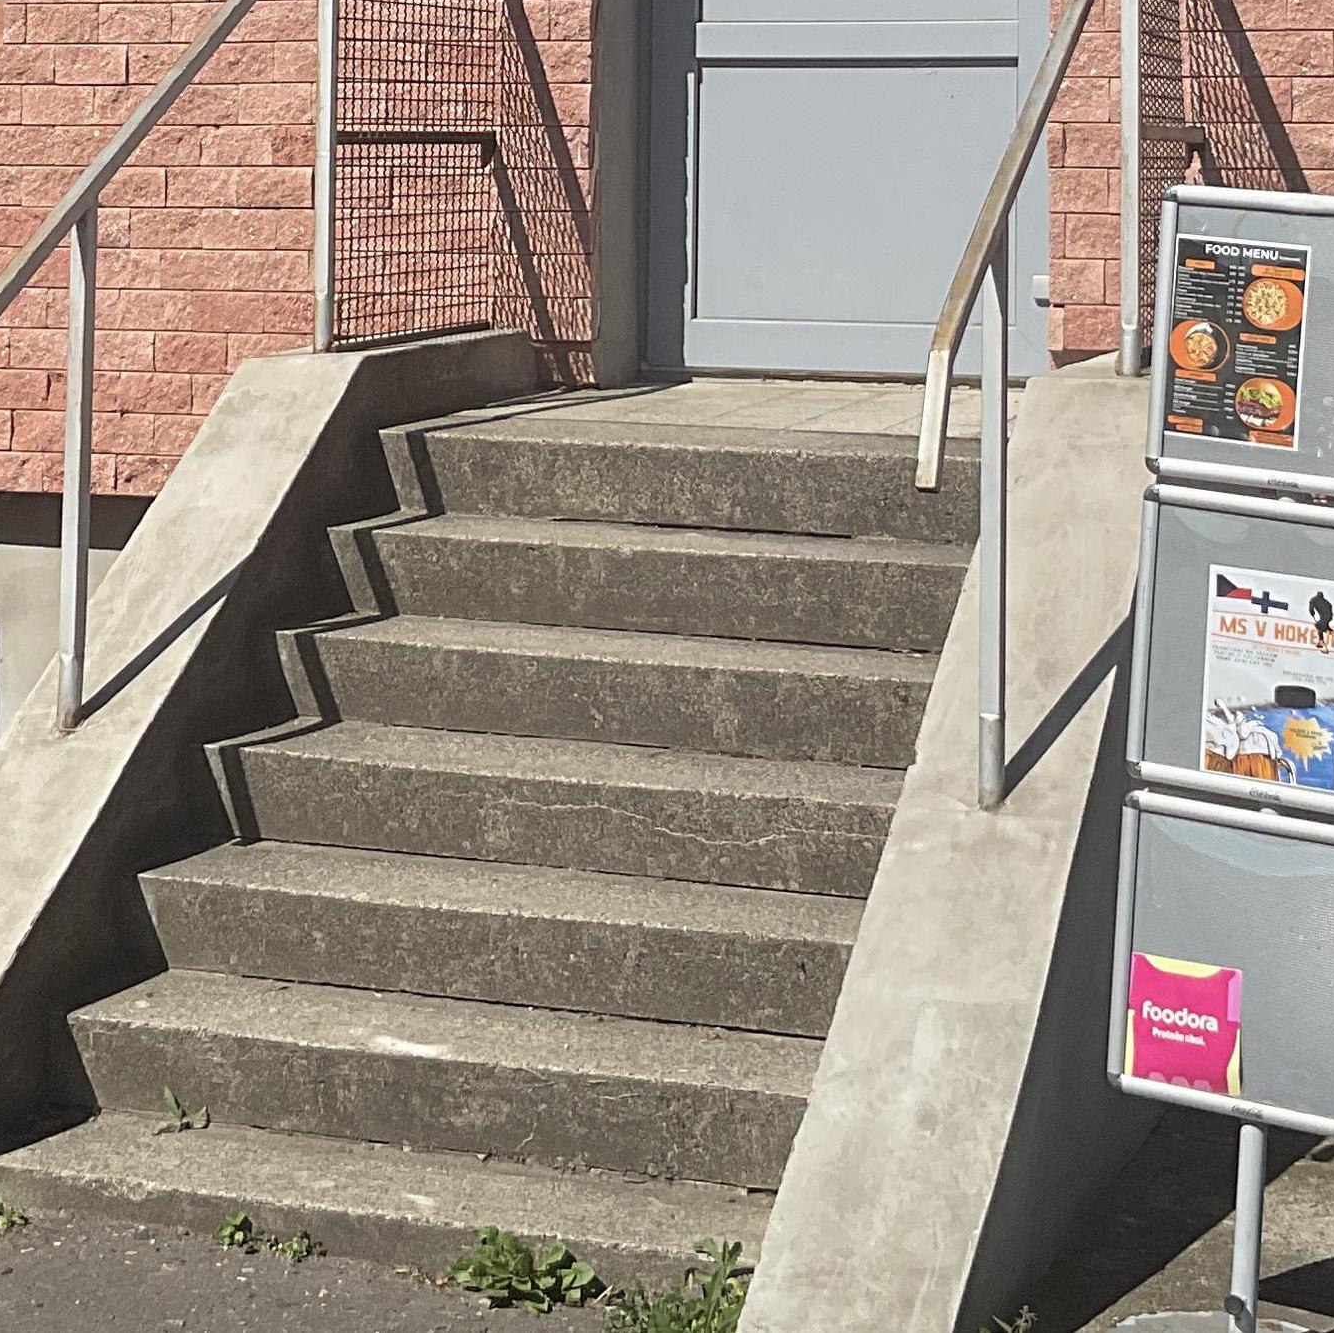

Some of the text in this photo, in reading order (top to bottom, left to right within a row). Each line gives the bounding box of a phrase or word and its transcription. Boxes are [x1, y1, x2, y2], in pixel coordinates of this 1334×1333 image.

[1205, 243, 1240, 257] FOOD
[1242, 247, 1279, 261] MENU
[1219, 615, 1247, 636] MS
[1255, 621, 1267, 638] V
[1142, 1000, 1218, 1033] foodora
